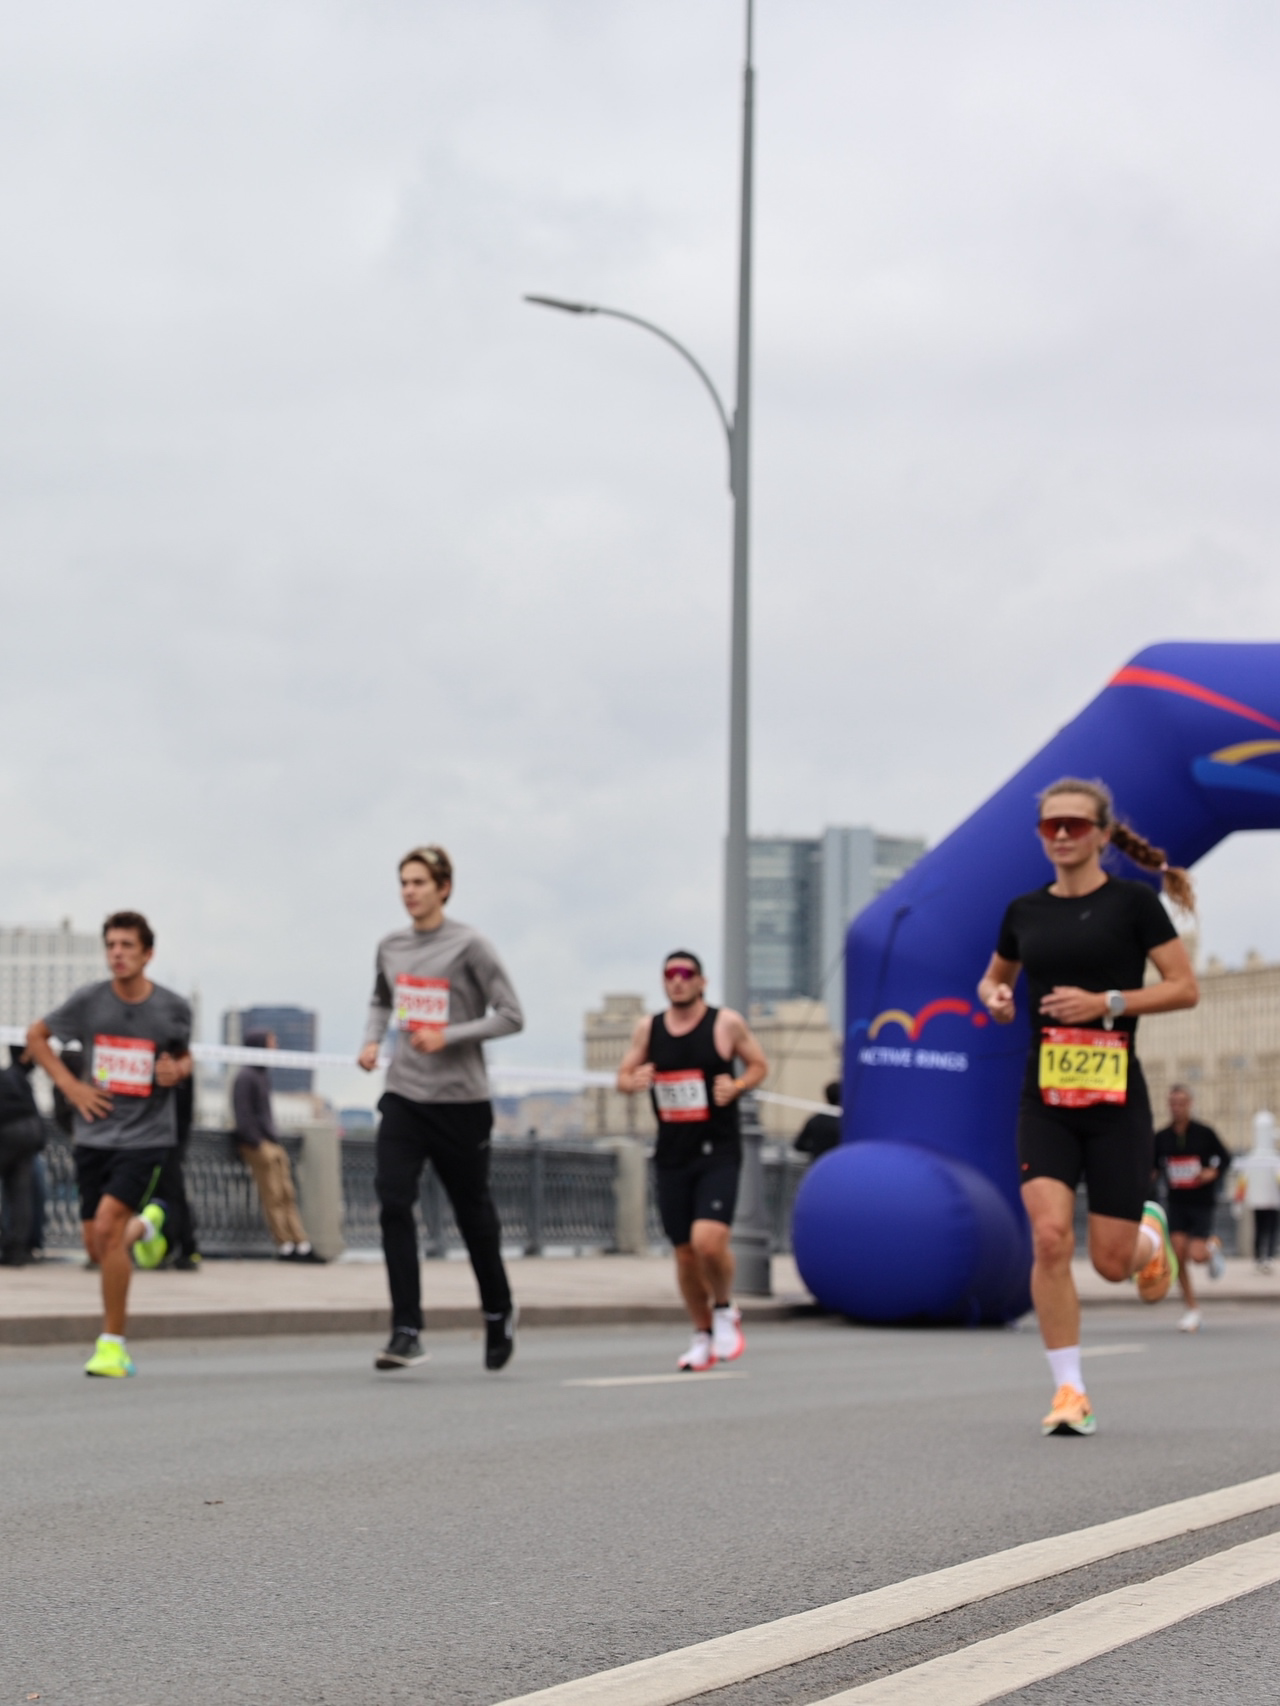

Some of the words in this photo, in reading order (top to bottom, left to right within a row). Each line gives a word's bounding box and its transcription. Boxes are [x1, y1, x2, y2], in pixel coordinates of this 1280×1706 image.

[858, 1046, 912, 1068] ACTIVE
[914, 1048, 969, 1072] RINGS
[1046, 1049, 1122, 1076] 16271
